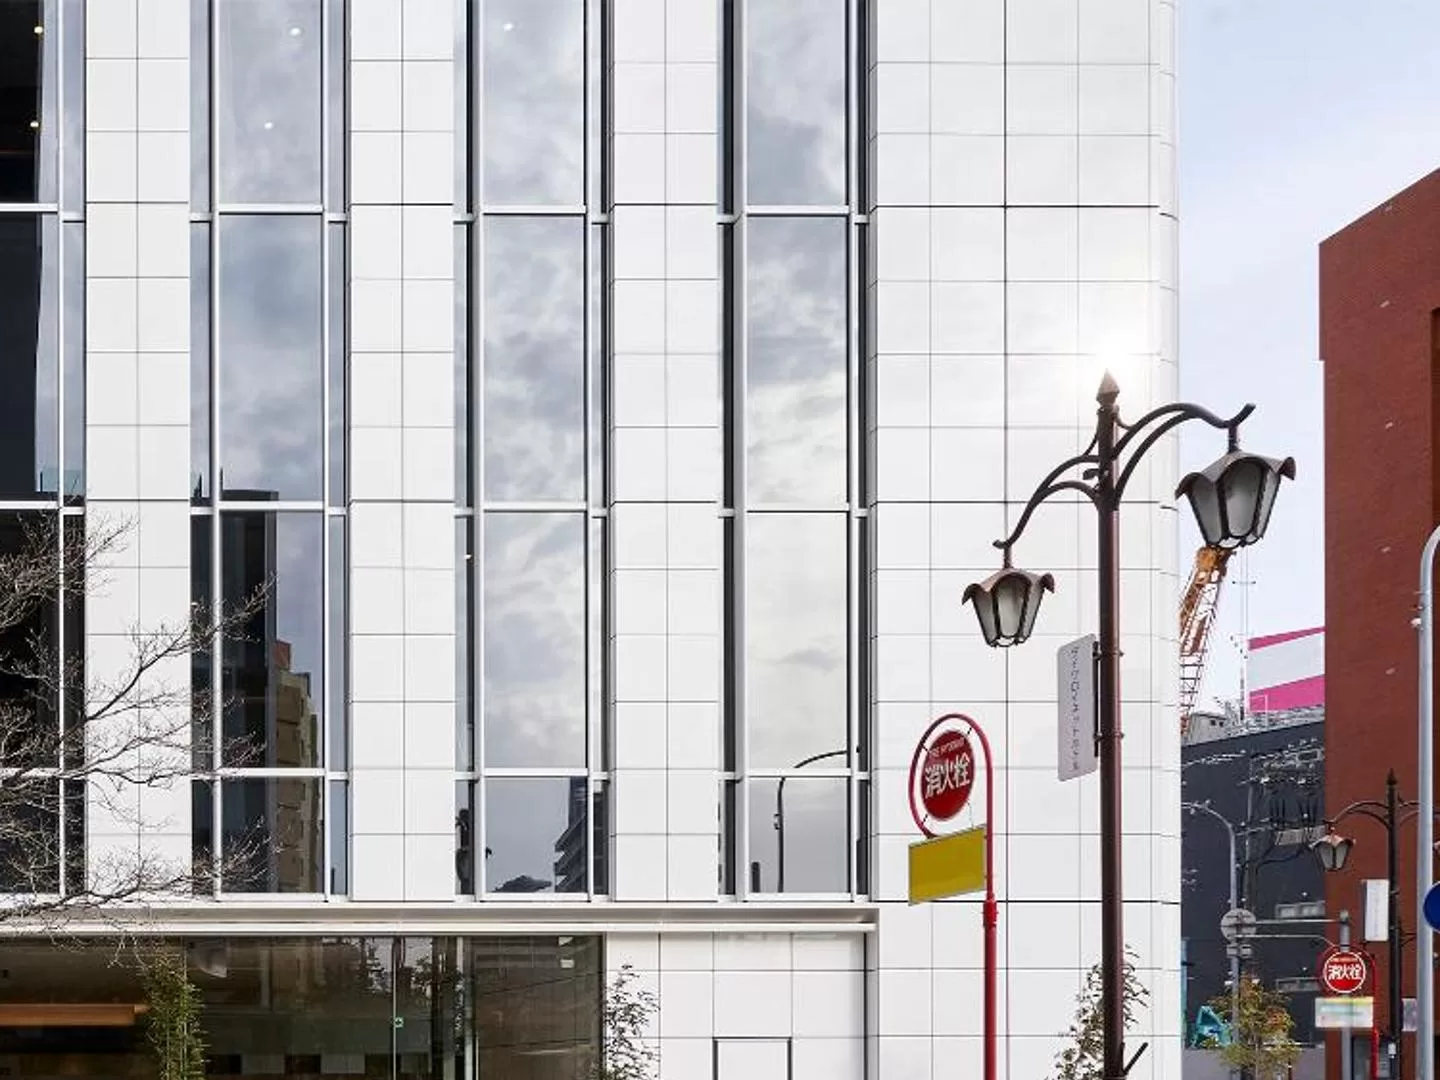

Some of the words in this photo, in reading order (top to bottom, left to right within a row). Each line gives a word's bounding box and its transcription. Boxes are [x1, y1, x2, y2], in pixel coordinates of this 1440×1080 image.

[925, 752, 970, 798] 消火栓
[1328, 964, 1362, 980] 消火栓
